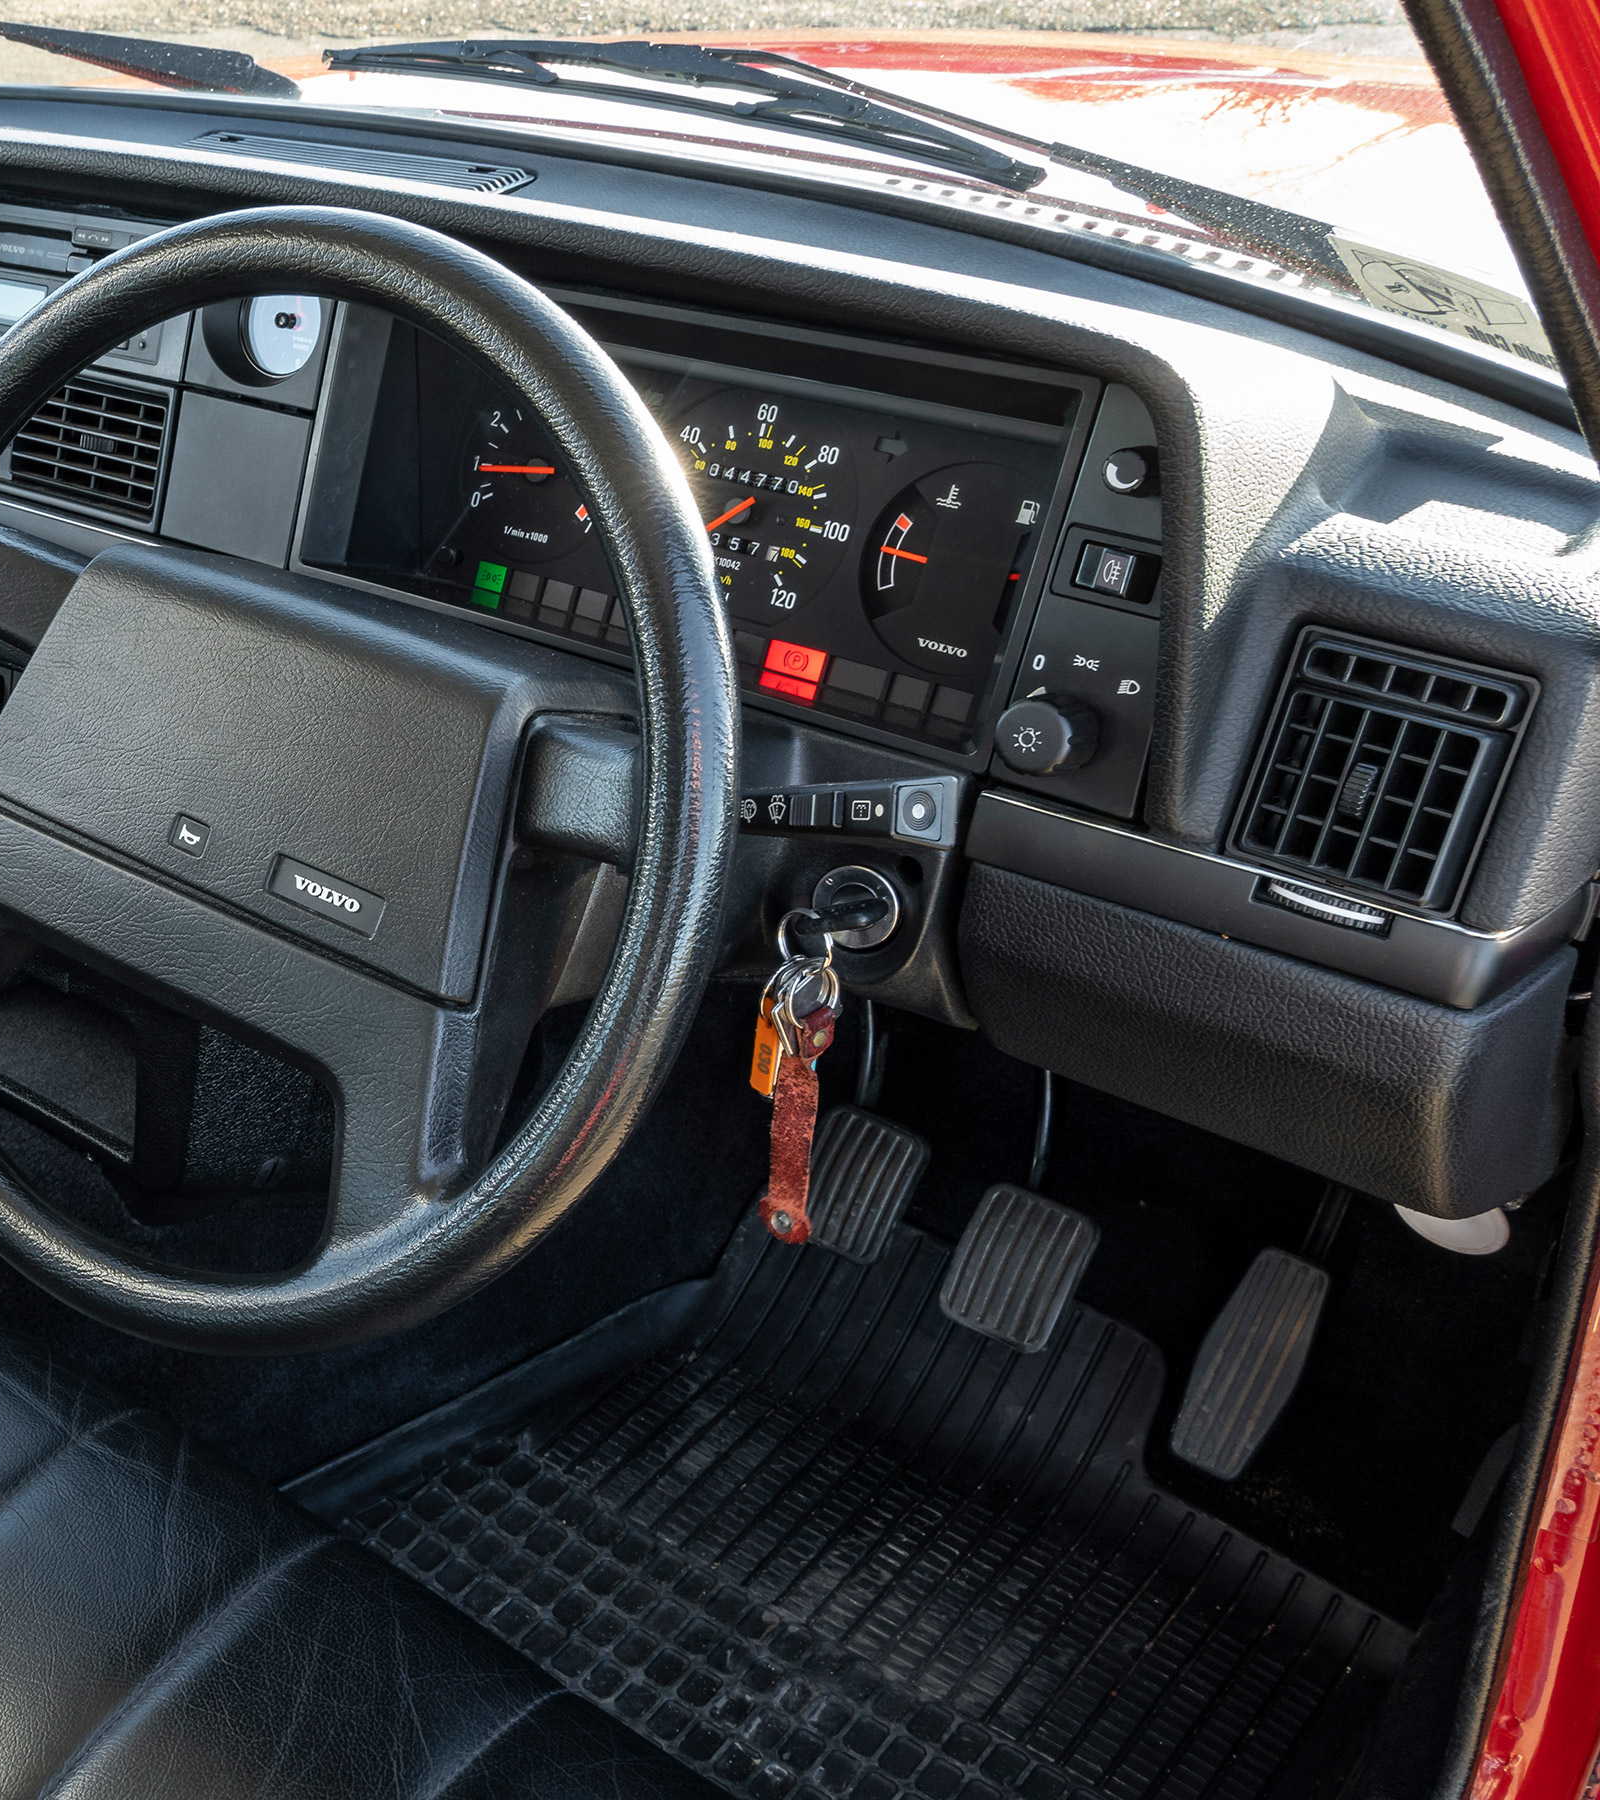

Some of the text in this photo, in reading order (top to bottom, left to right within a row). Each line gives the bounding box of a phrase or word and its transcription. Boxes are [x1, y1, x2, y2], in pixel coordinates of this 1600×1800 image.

[490, 410, 501, 427] 2
[757, 403, 778, 423] 60
[680, 425, 701, 444] 40
[725, 440, 737, 451] 80
[758, 438, 773, 450] 100
[473, 455, 481, 472] 1
[784, 455, 799, 467] 120
[817, 445, 840, 465] 80
[694, 460, 706, 470] 60
[470, 491, 481, 508] 0
[798, 485, 813, 497] 140
[796, 517, 811, 529] 160
[823, 520, 851, 543] 100
[780, 547, 795, 559] 180
[770, 588, 797, 610] 120
[917, 637, 969, 659] VOLVO
[1032, 654, 1046, 671] 0
[294, 874, 361, 913] VOLVO
